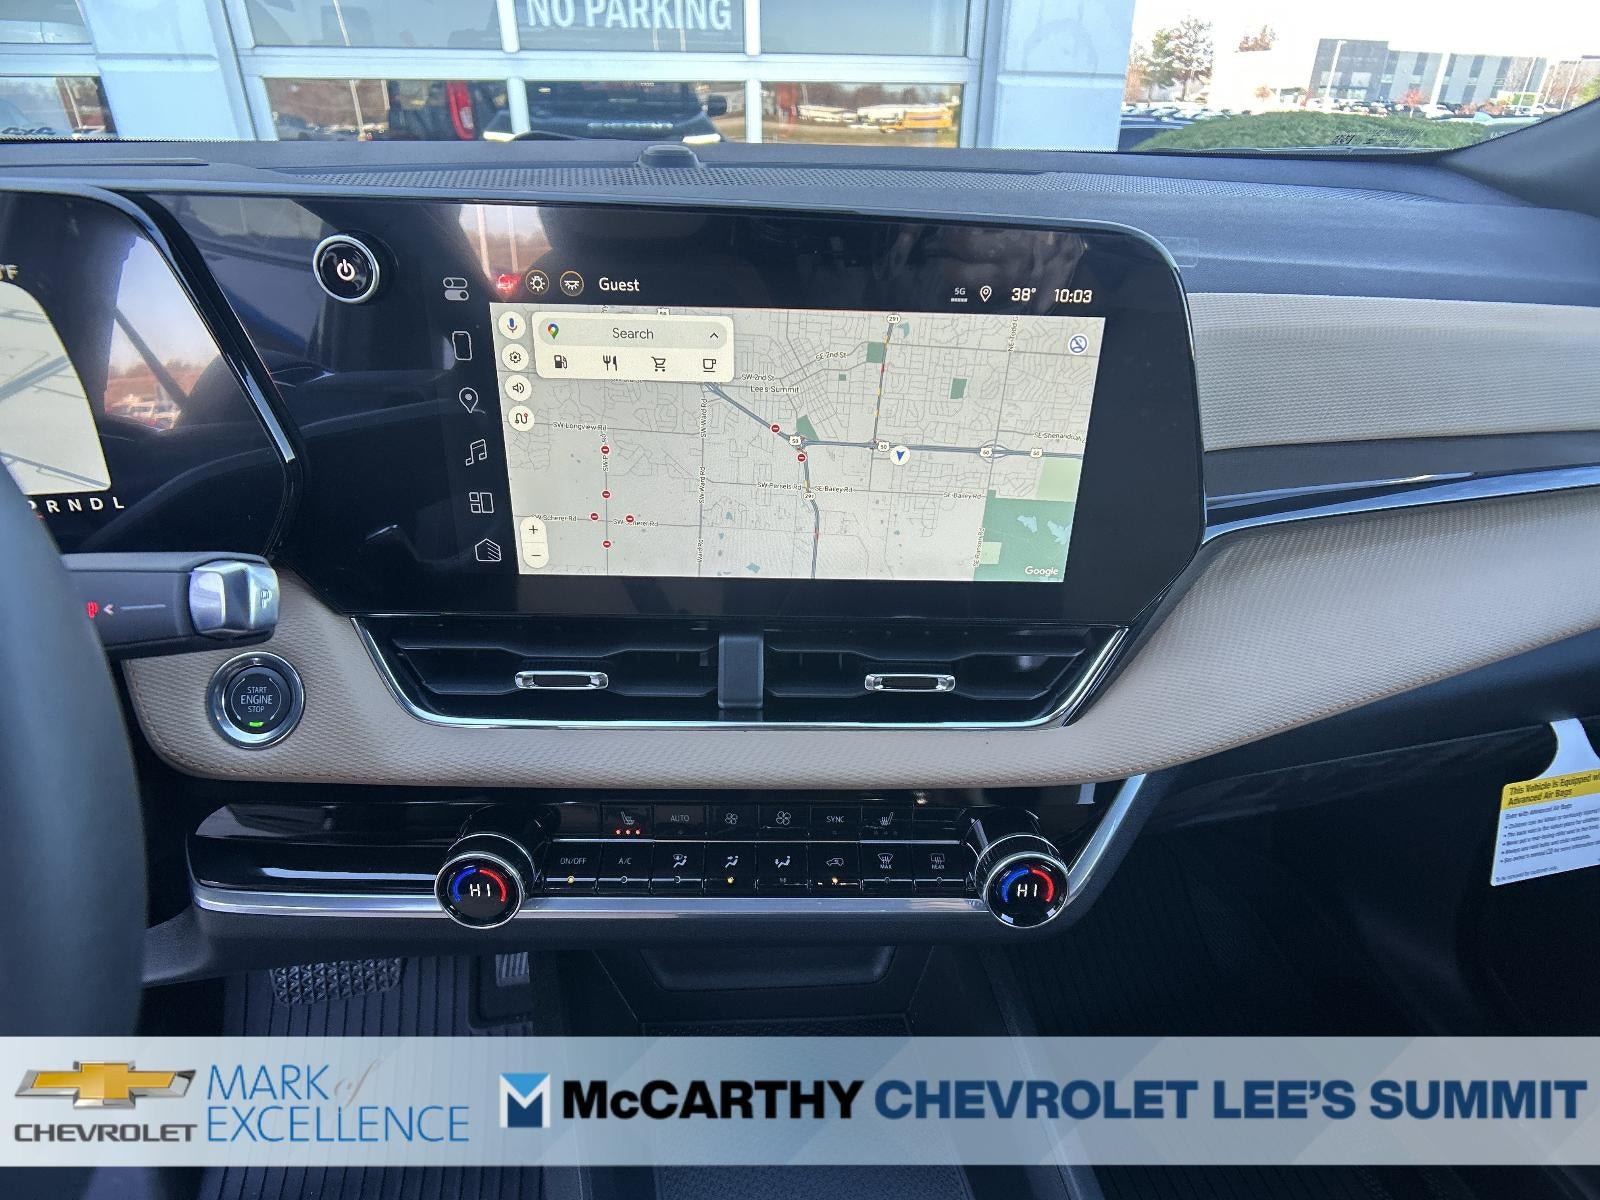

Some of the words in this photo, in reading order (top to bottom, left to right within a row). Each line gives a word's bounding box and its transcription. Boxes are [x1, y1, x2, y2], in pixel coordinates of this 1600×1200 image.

[526, 0, 576, 27] NO
[585, 0, 732, 30] PARKING
[598, 277, 640, 292] Guest
[954, 287, 966, 295] 5G
[1011, 287, 1037, 301] 38°
[1054, 288, 1093, 303] 10:03
[612, 327, 654, 340] Search
[770, 385, 800, 393] Summit
[45, 499, 60, 514] R
[67, 498, 82, 512] N
[89, 497, 104, 511] D
[112, 496, 125, 509] L
[1024, 565, 1059, 577] Google
[247, 686, 267, 694] START
[240, 694, 273, 705] ENGINE
[247, 705, 265, 713] STOP
[1509, 786, 1524, 795] This
[1525, 782, 1552, 793] Vehicle
[1560, 773, 1592, 788] Equipped
[1507, 793, 1542, 806] Advanced
[1543, 791, 1554, 799] Air
[670, 814, 690, 822] AUTO
[826, 815, 845, 823] SYNC
[560, 857, 587, 865] ON/OFF
[618, 857, 632, 865] A/C
